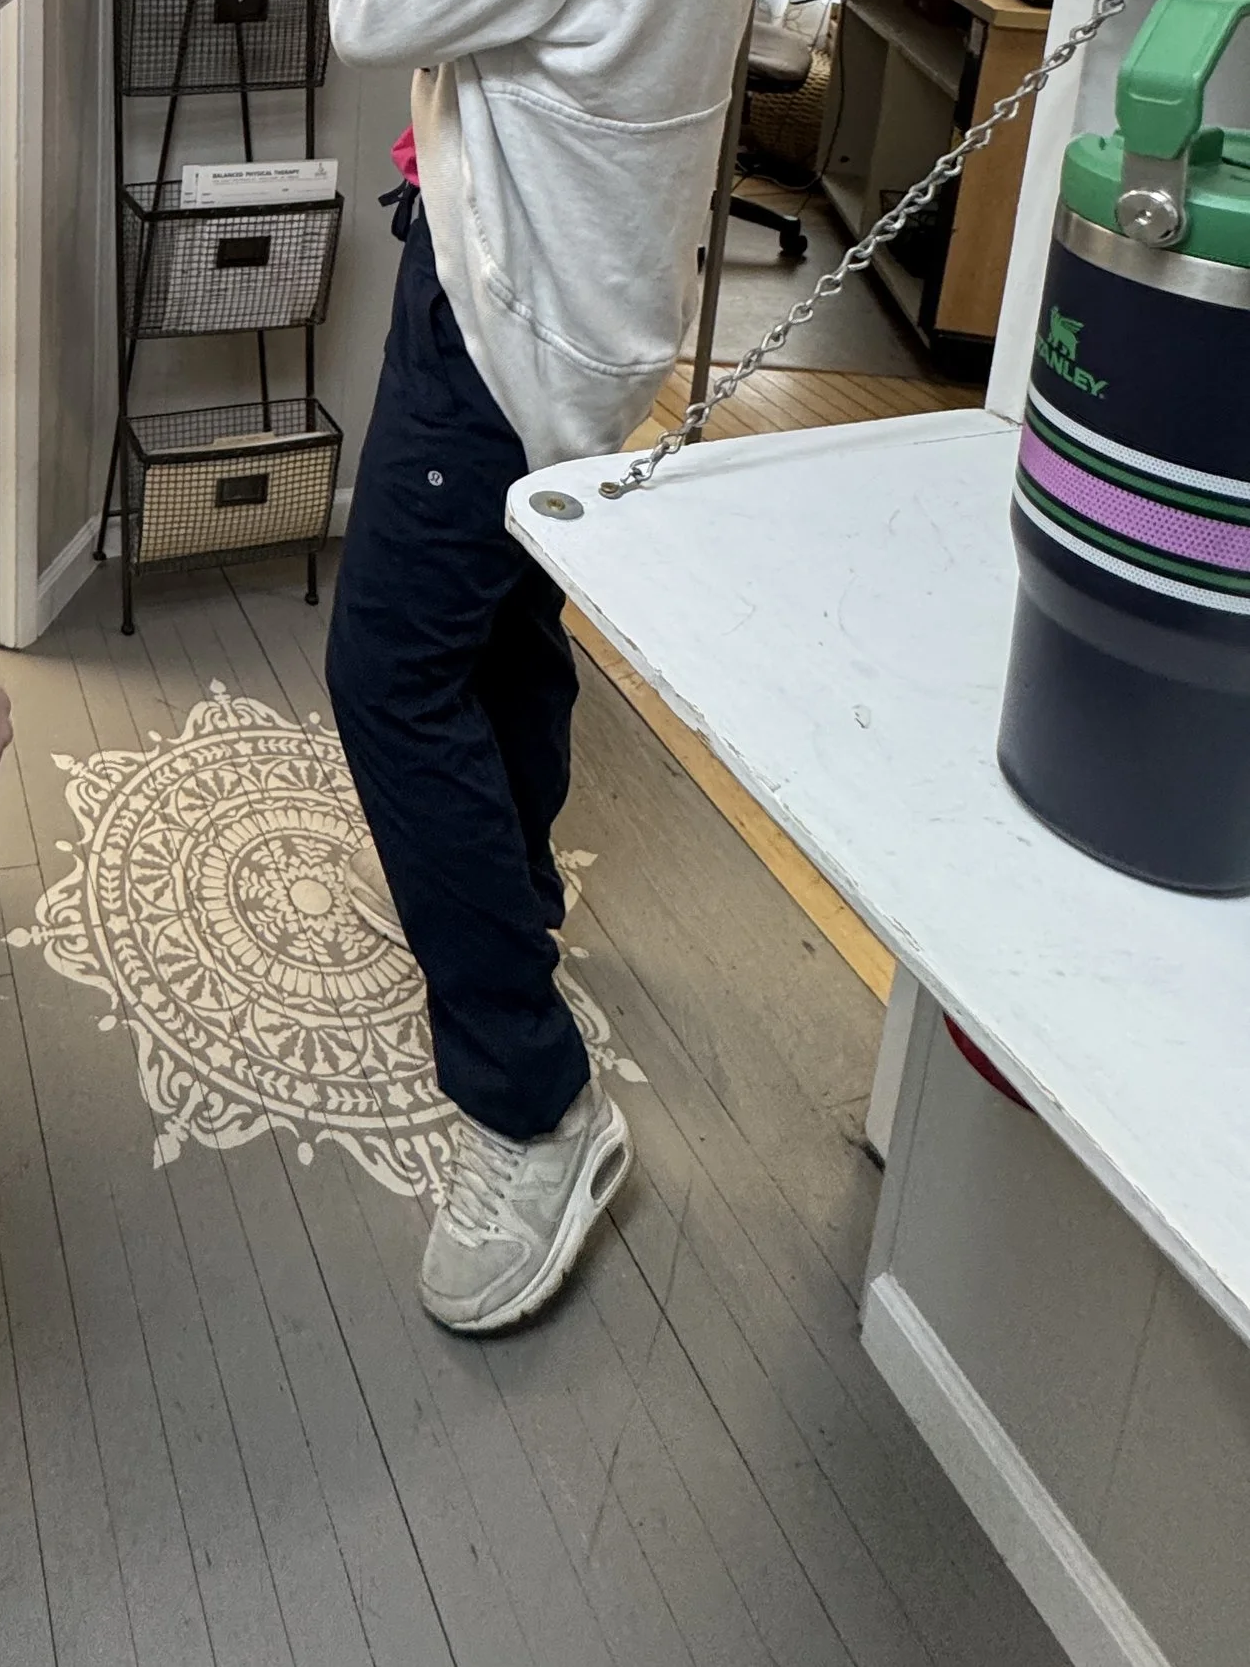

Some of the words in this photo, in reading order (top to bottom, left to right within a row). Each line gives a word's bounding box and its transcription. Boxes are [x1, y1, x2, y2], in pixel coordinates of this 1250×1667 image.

[212, 171, 244, 179] BALANCED
[245, 169, 272, 177] PHYSICAL
[1035, 334, 1109, 396] TANLEY
